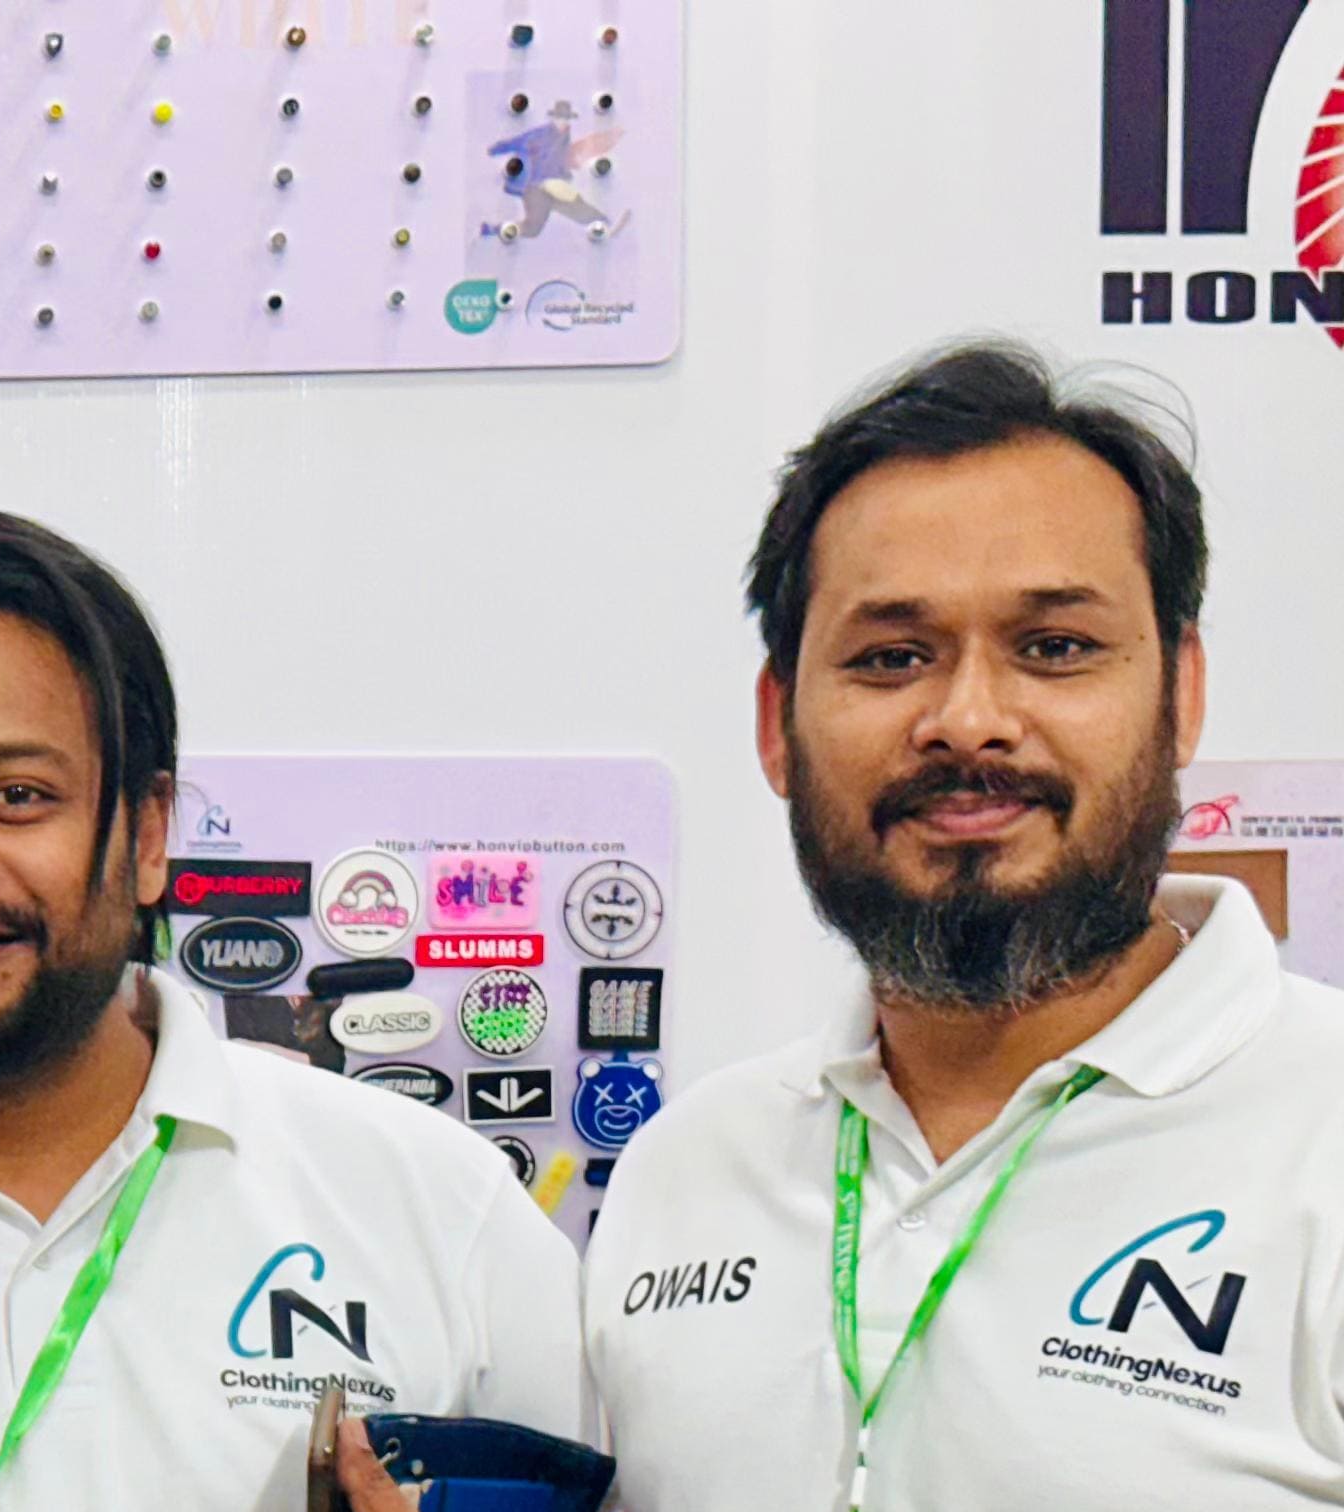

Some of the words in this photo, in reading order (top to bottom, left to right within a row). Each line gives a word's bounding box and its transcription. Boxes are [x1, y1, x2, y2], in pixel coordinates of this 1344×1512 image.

[429, 938, 534, 960] SLUMMS
[344, 1010, 431, 1035] CLASSIC
[623, 1256, 758, 1316] OWAIS
[219, 1368, 397, 1403] ClothingNexus
[1040, 1336, 1243, 1400] ClothingNexus
[226, 1393, 259, 1410] your
[1038, 1363, 1071, 1380] your
[1071, 1367, 1135, 1396] clothing
[1135, 1385, 1227, 1418] connection
